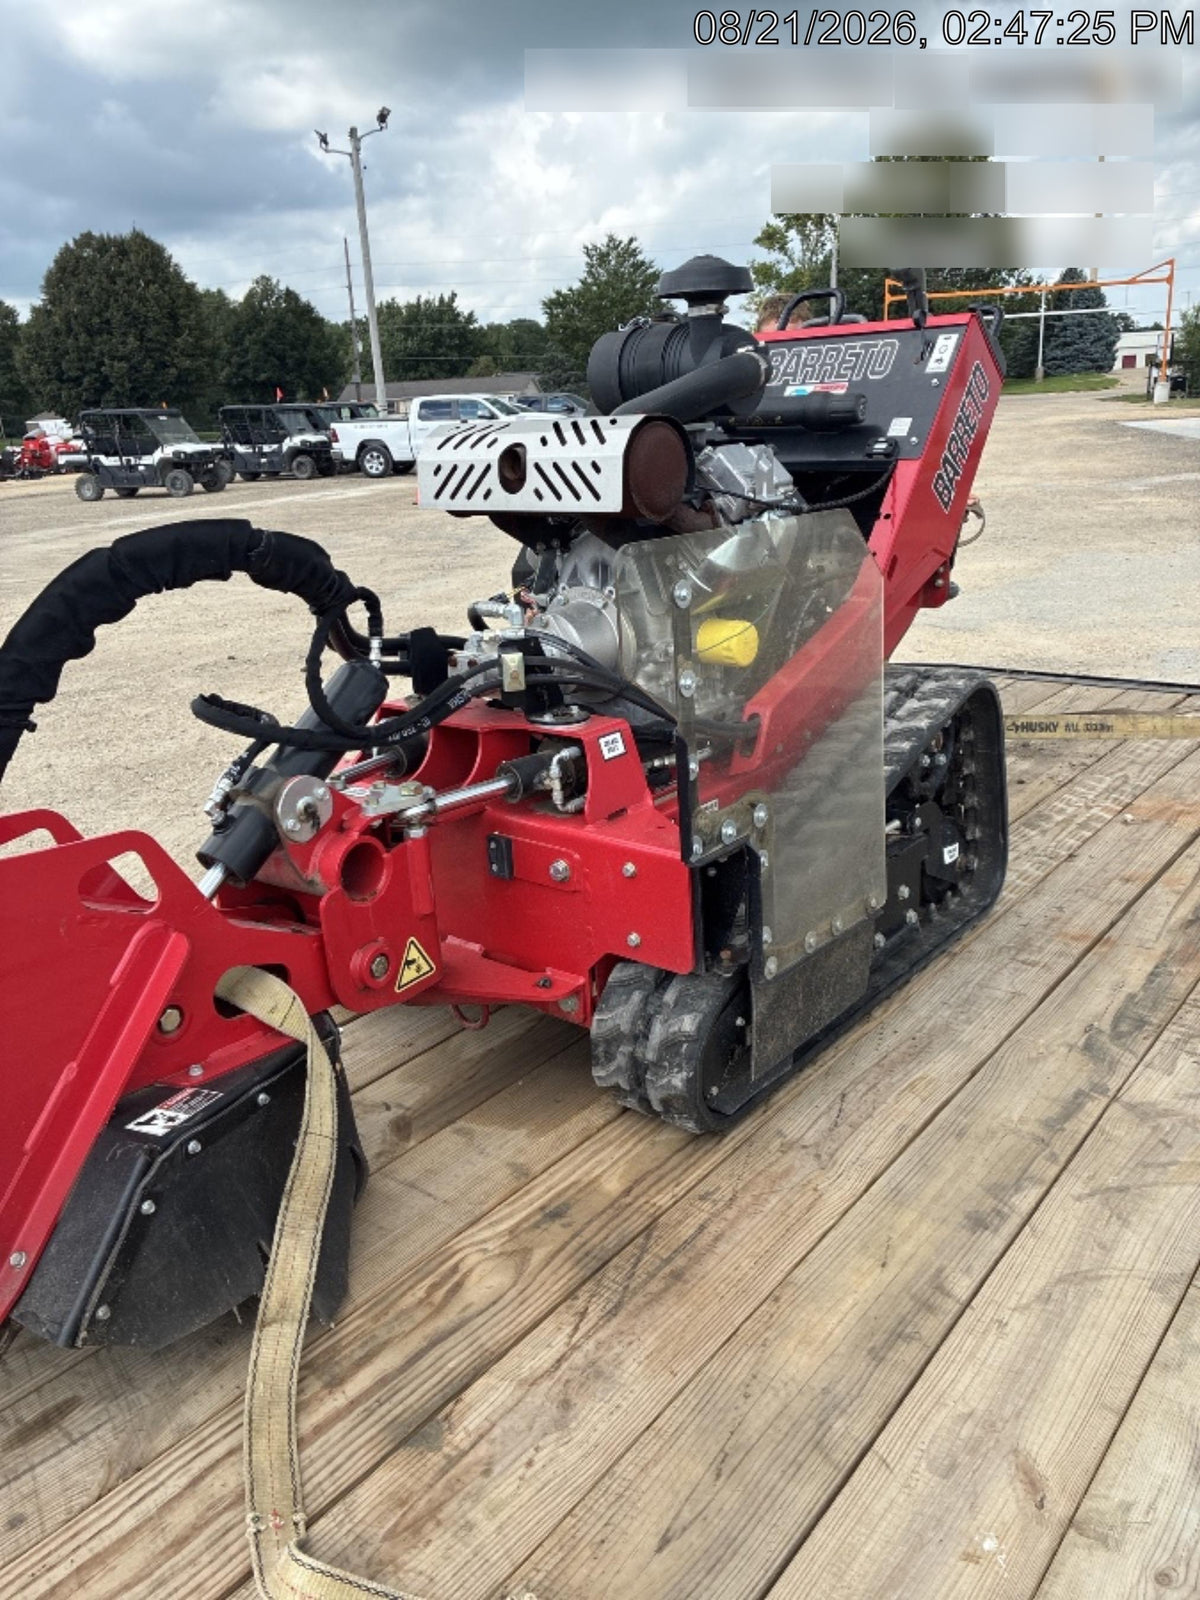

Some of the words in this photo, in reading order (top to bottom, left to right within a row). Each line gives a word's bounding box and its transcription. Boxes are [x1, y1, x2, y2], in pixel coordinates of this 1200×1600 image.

[766, 339, 899, 387] BARRETO
[931, 360, 990, 515] BARRETO
[1019, 721, 1059, 733] HUSKY
